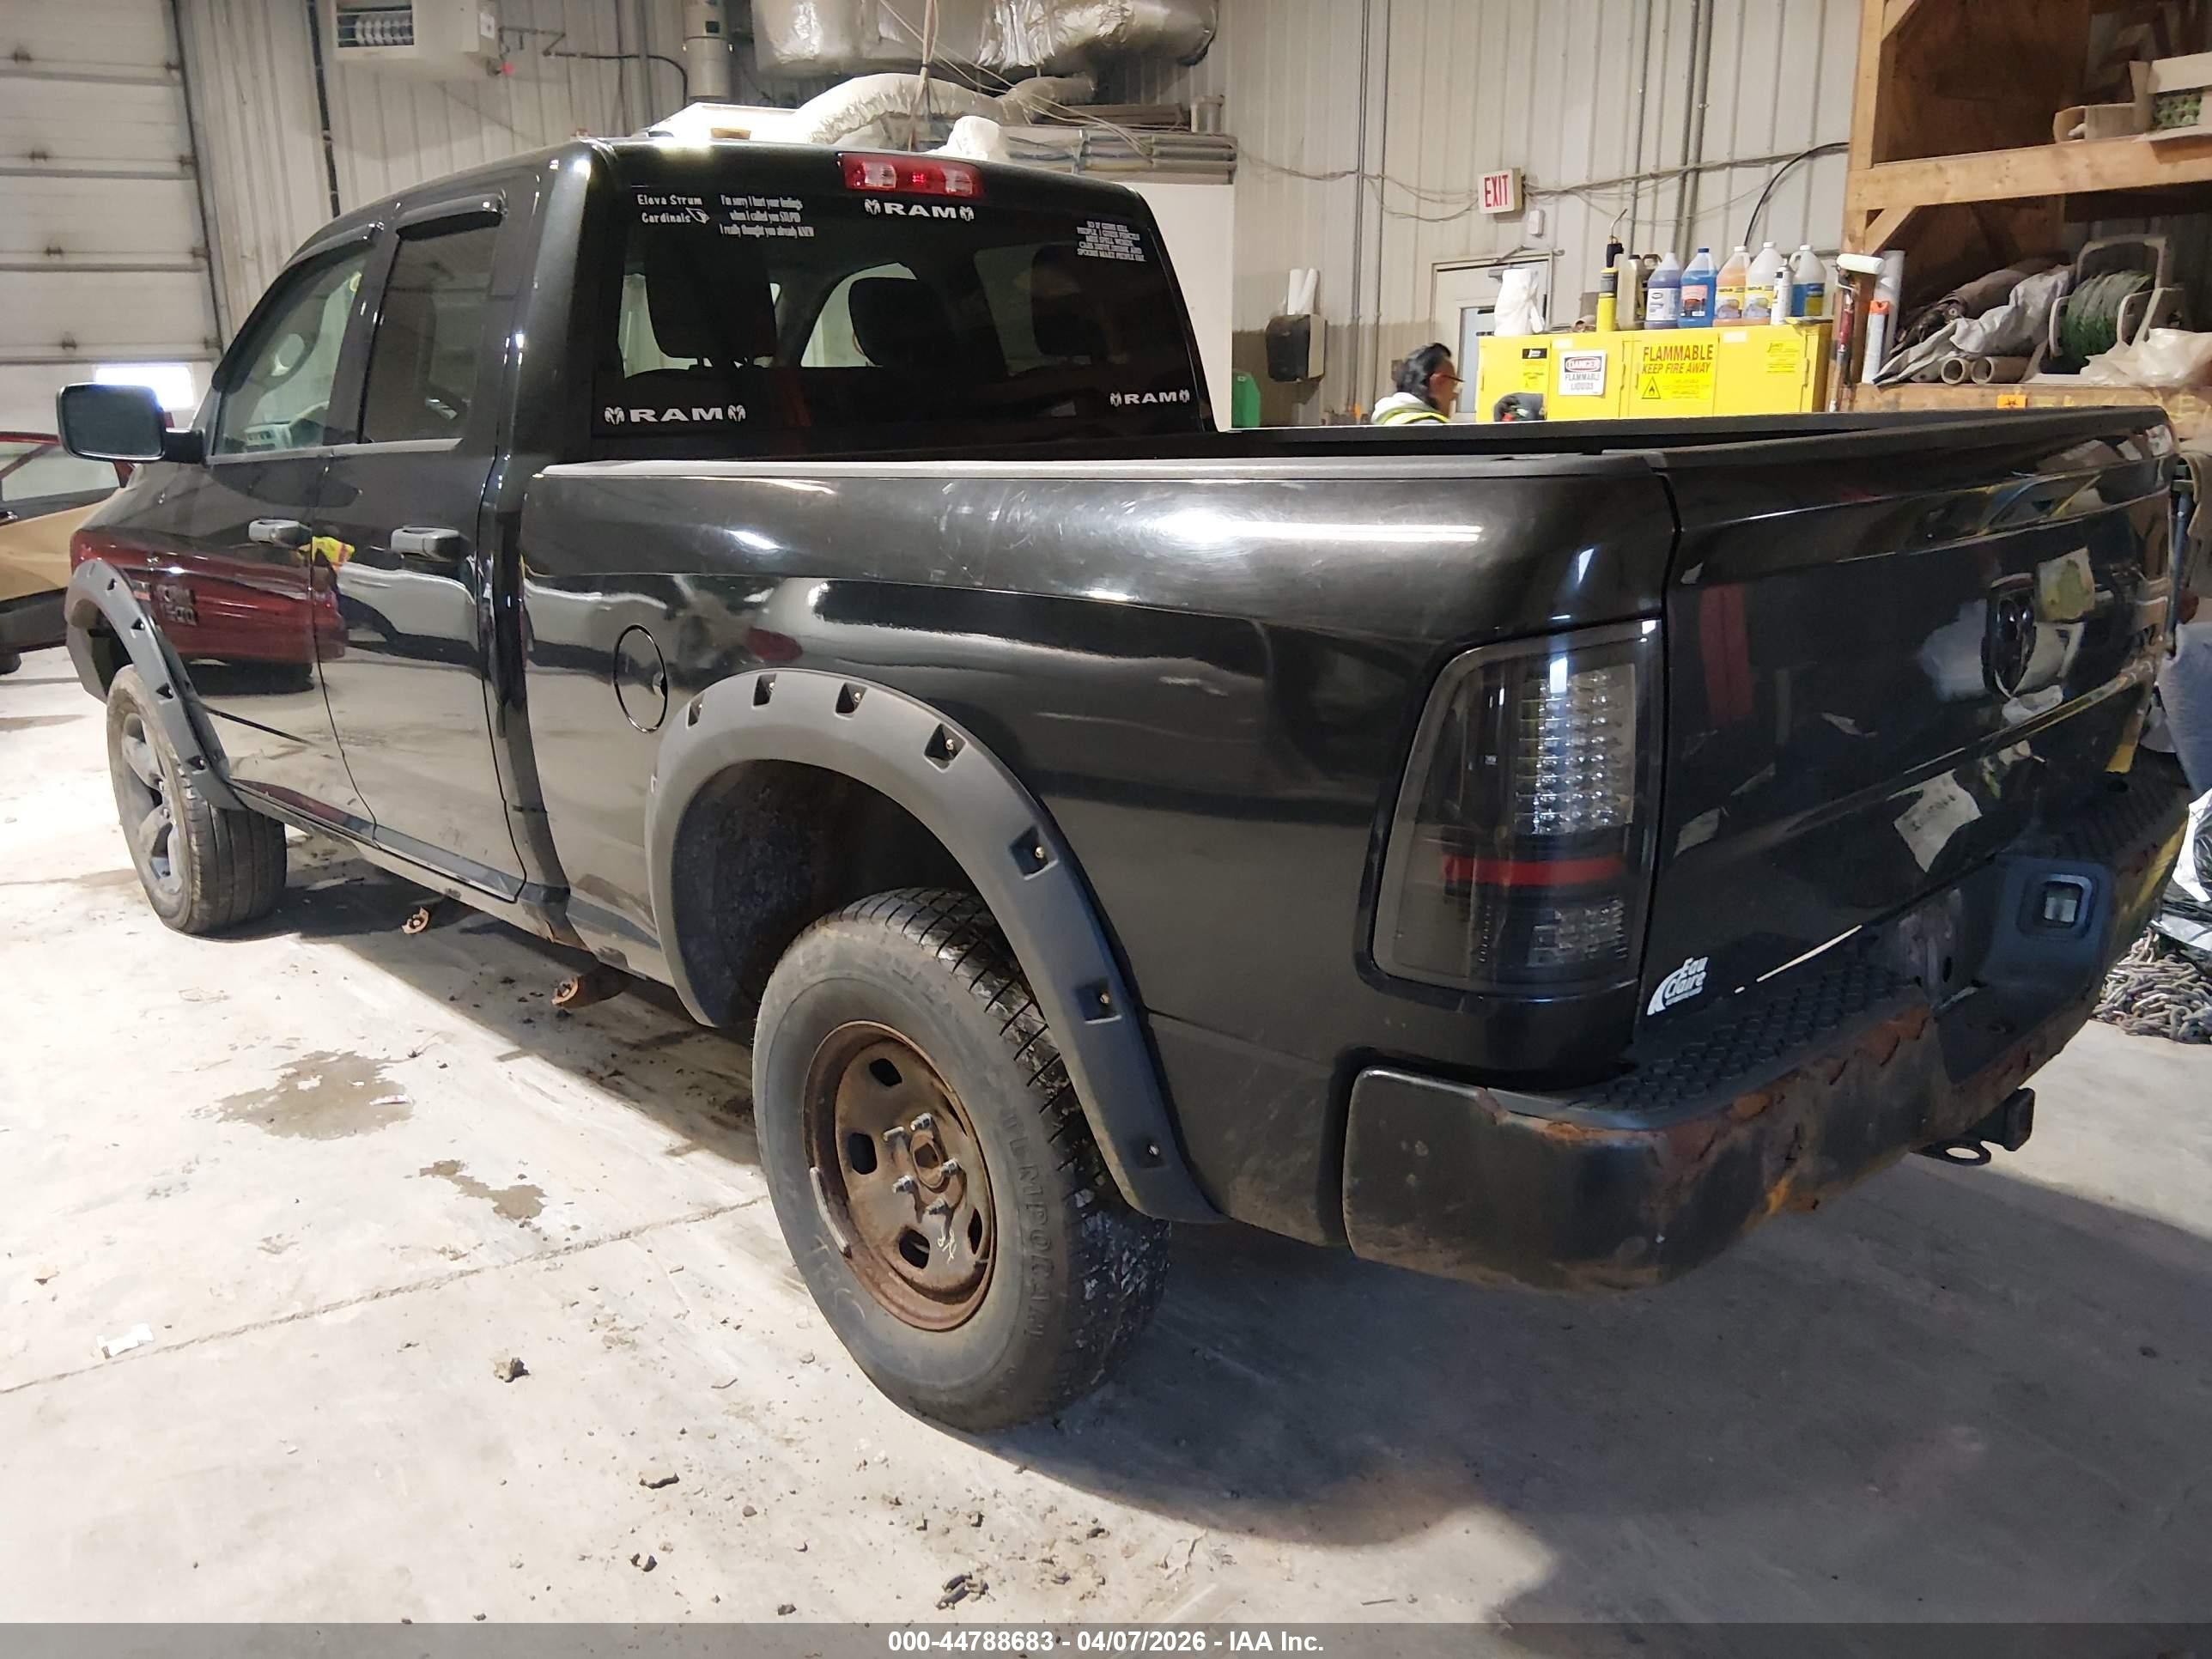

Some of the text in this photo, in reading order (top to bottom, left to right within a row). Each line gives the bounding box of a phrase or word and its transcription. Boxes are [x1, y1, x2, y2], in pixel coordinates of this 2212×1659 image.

[1484, 174, 1508, 207] EXIT
[641, 212, 691, 223] Cardinals
[884, 202, 957, 219] RAM
[1643, 344, 1714, 362] FLAMMABLE
[1642, 362, 1711, 374] KEEP FIRE AWAY
[1124, 392, 1177, 404] RAM
[629, 407, 723, 422] RAM
